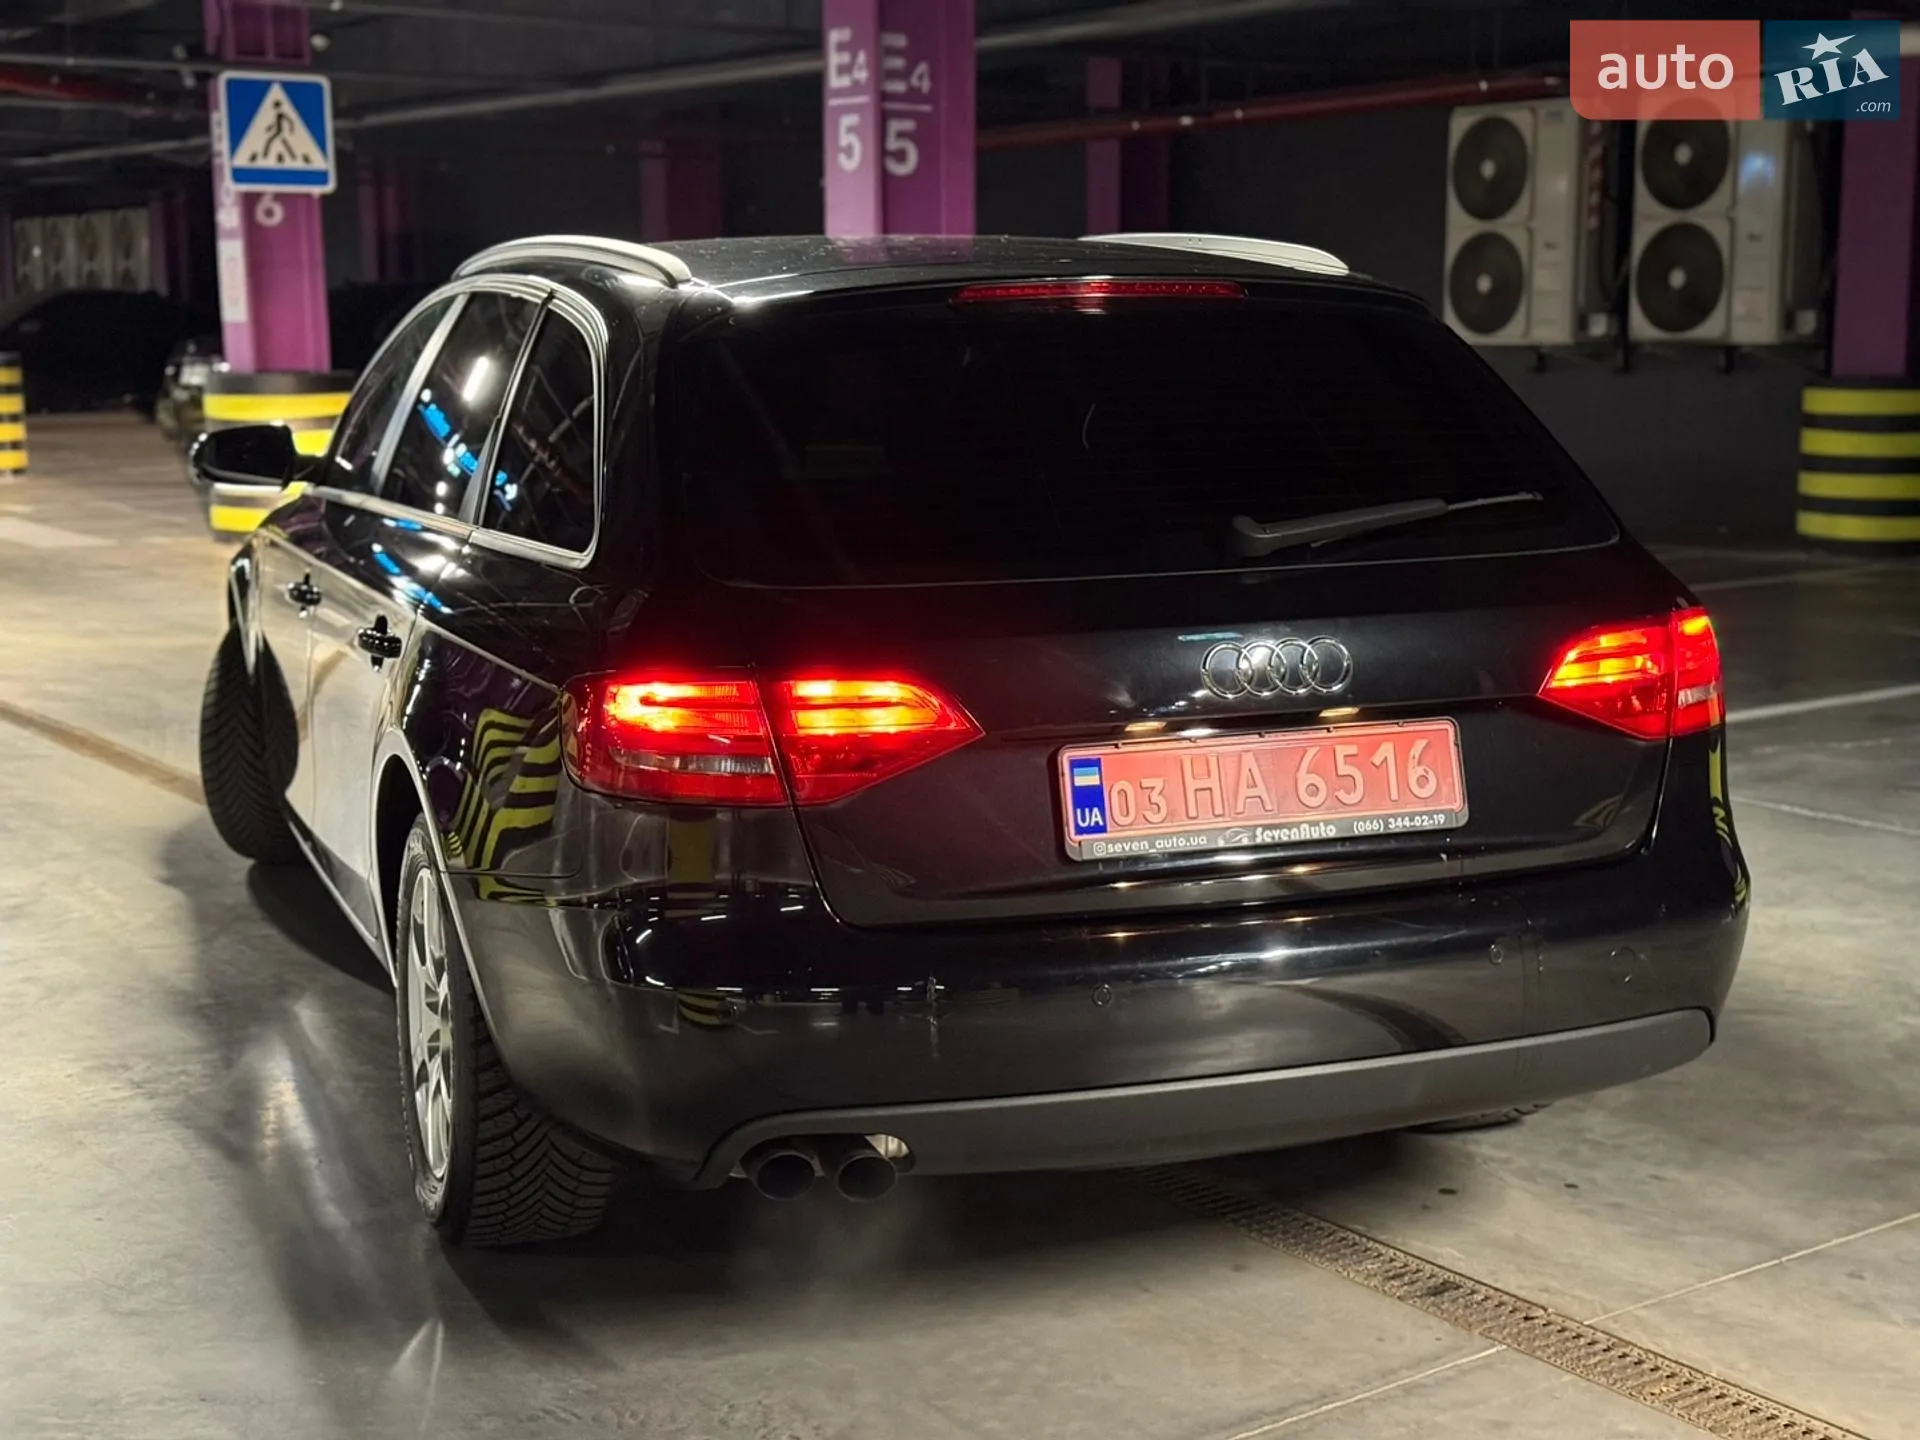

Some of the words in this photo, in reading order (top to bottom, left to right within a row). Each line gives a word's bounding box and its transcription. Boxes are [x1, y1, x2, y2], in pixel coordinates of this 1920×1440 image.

[838, 113, 862, 173] 5
[884, 118, 919, 177] 5
[255, 191, 284, 227] 6
[1109, 778, 1168, 825] 03
[1180, 751, 1275, 819] HA
[1295, 738, 1438, 809] 6516
[1076, 807, 1104, 827] UA
[1255, 822, 1337, 843] SevenAuto
[1353, 819, 1384, 834] (066)
[1388, 814, 1446, 830] 344-02-19
